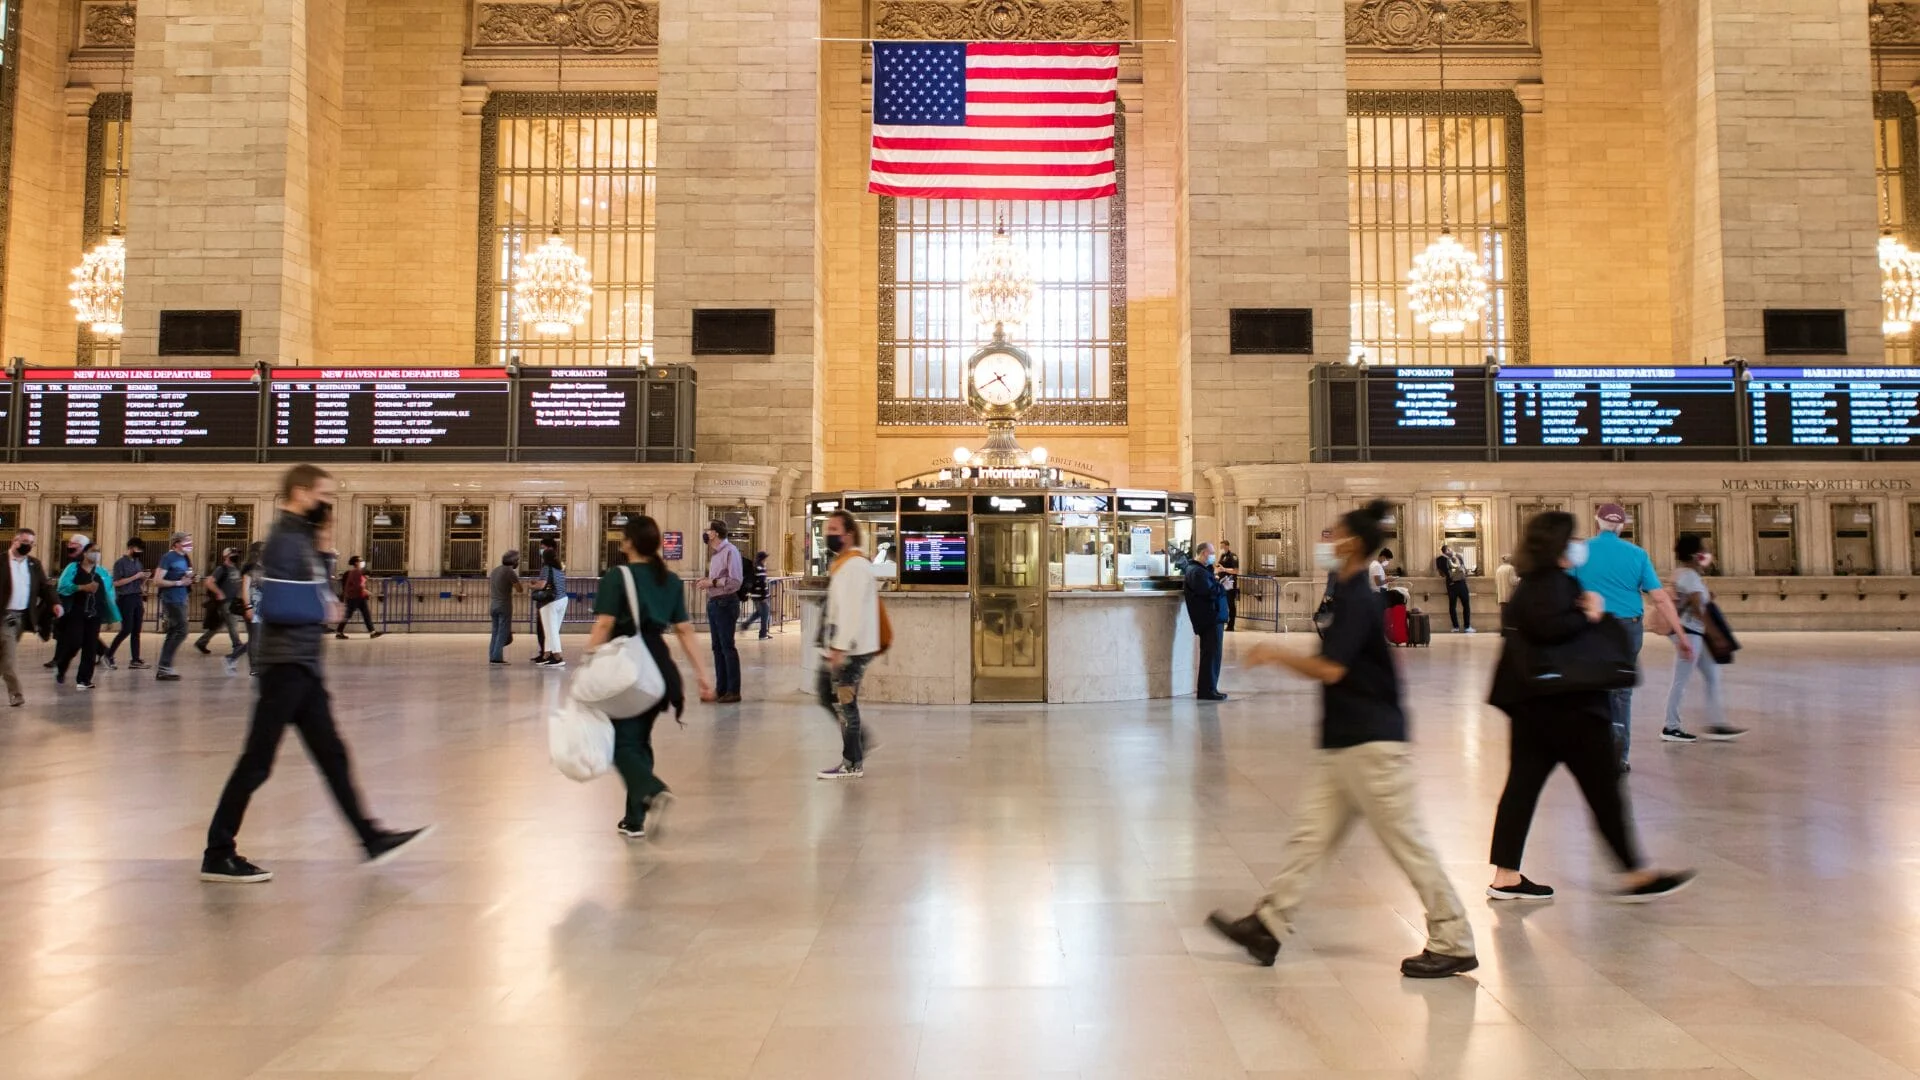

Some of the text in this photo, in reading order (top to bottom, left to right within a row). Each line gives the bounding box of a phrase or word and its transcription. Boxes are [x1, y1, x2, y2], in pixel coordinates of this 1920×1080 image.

[154, 370, 211, 378] DEPARTURES
[1398, 369, 1454, 377] INFORMATION
[1554, 369, 1675, 377] HARLEM LINE DEPARTURES
[1804, 369, 1841, 377] HARLEM
[1074, 460, 1094, 471] HALL
[978, 466, 1040, 479] Information
[1722, 479, 1912, 490] MTA METRO-NORTH TICKETS
